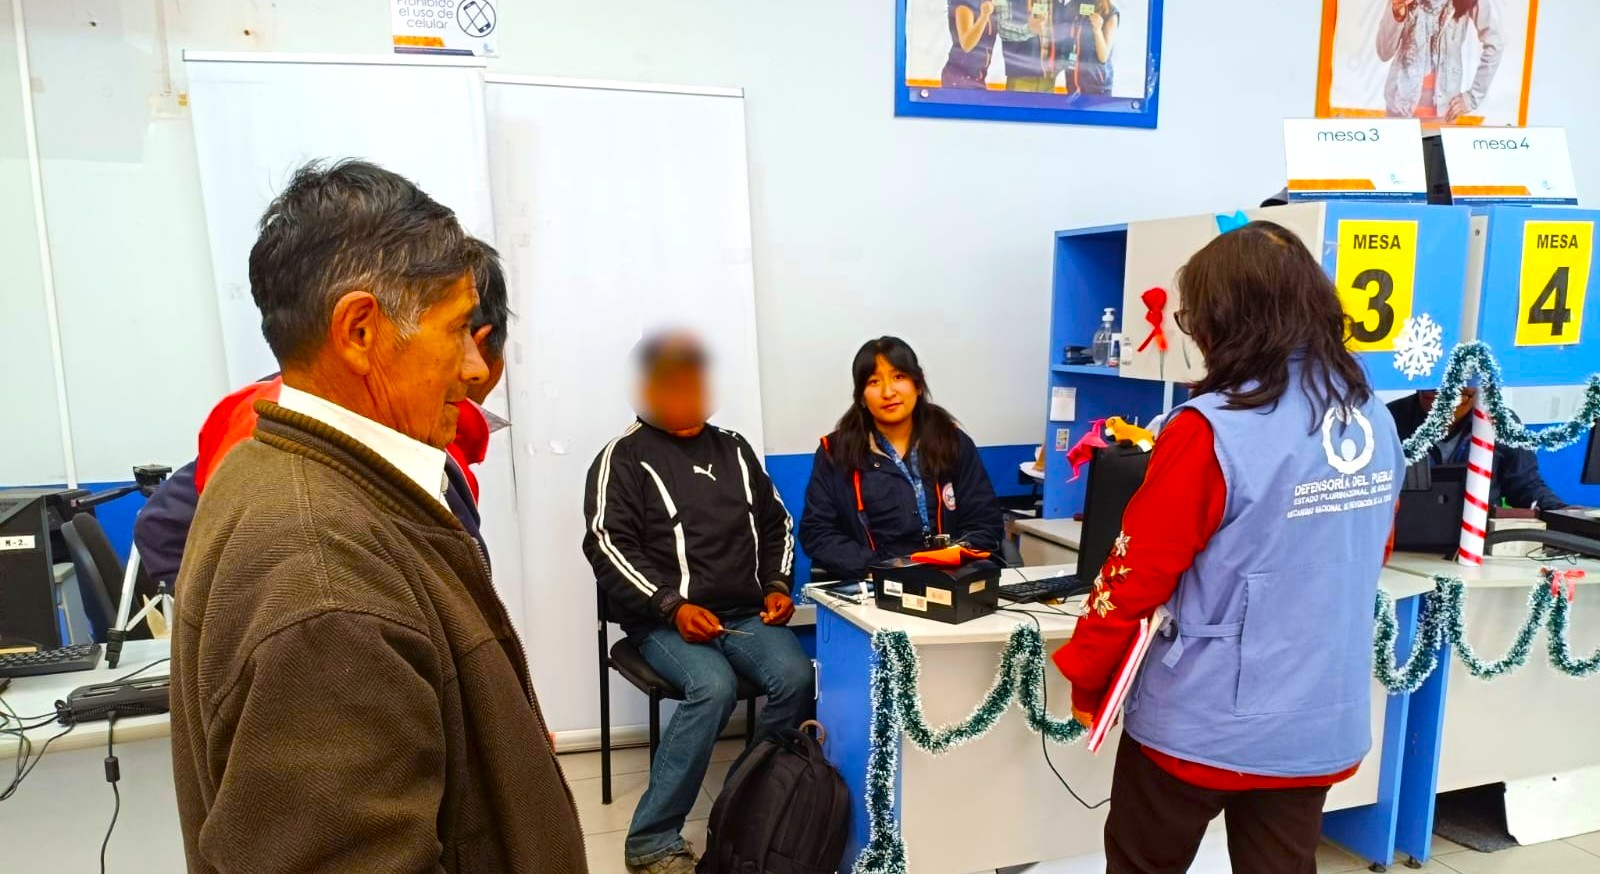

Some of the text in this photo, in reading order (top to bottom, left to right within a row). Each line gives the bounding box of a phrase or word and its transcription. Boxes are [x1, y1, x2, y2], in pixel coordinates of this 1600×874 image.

[399, 6, 454, 19] el uso de
[406, 18, 448, 29] celular
[1317, 128, 1380, 142] mesa 3
[1473, 137, 1530, 150] mesa 4
[1353, 234, 1402, 250] MESA
[1536, 234, 1579, 249] MESA
[1351, 268, 1395, 343] 3
[1528, 266, 1571, 336] 4
[1295, 474, 1350, 496] DEFENSORÍA
[1352, 475, 1369, 487] DEL
[1294, 495, 1318, 505] ESTADO
